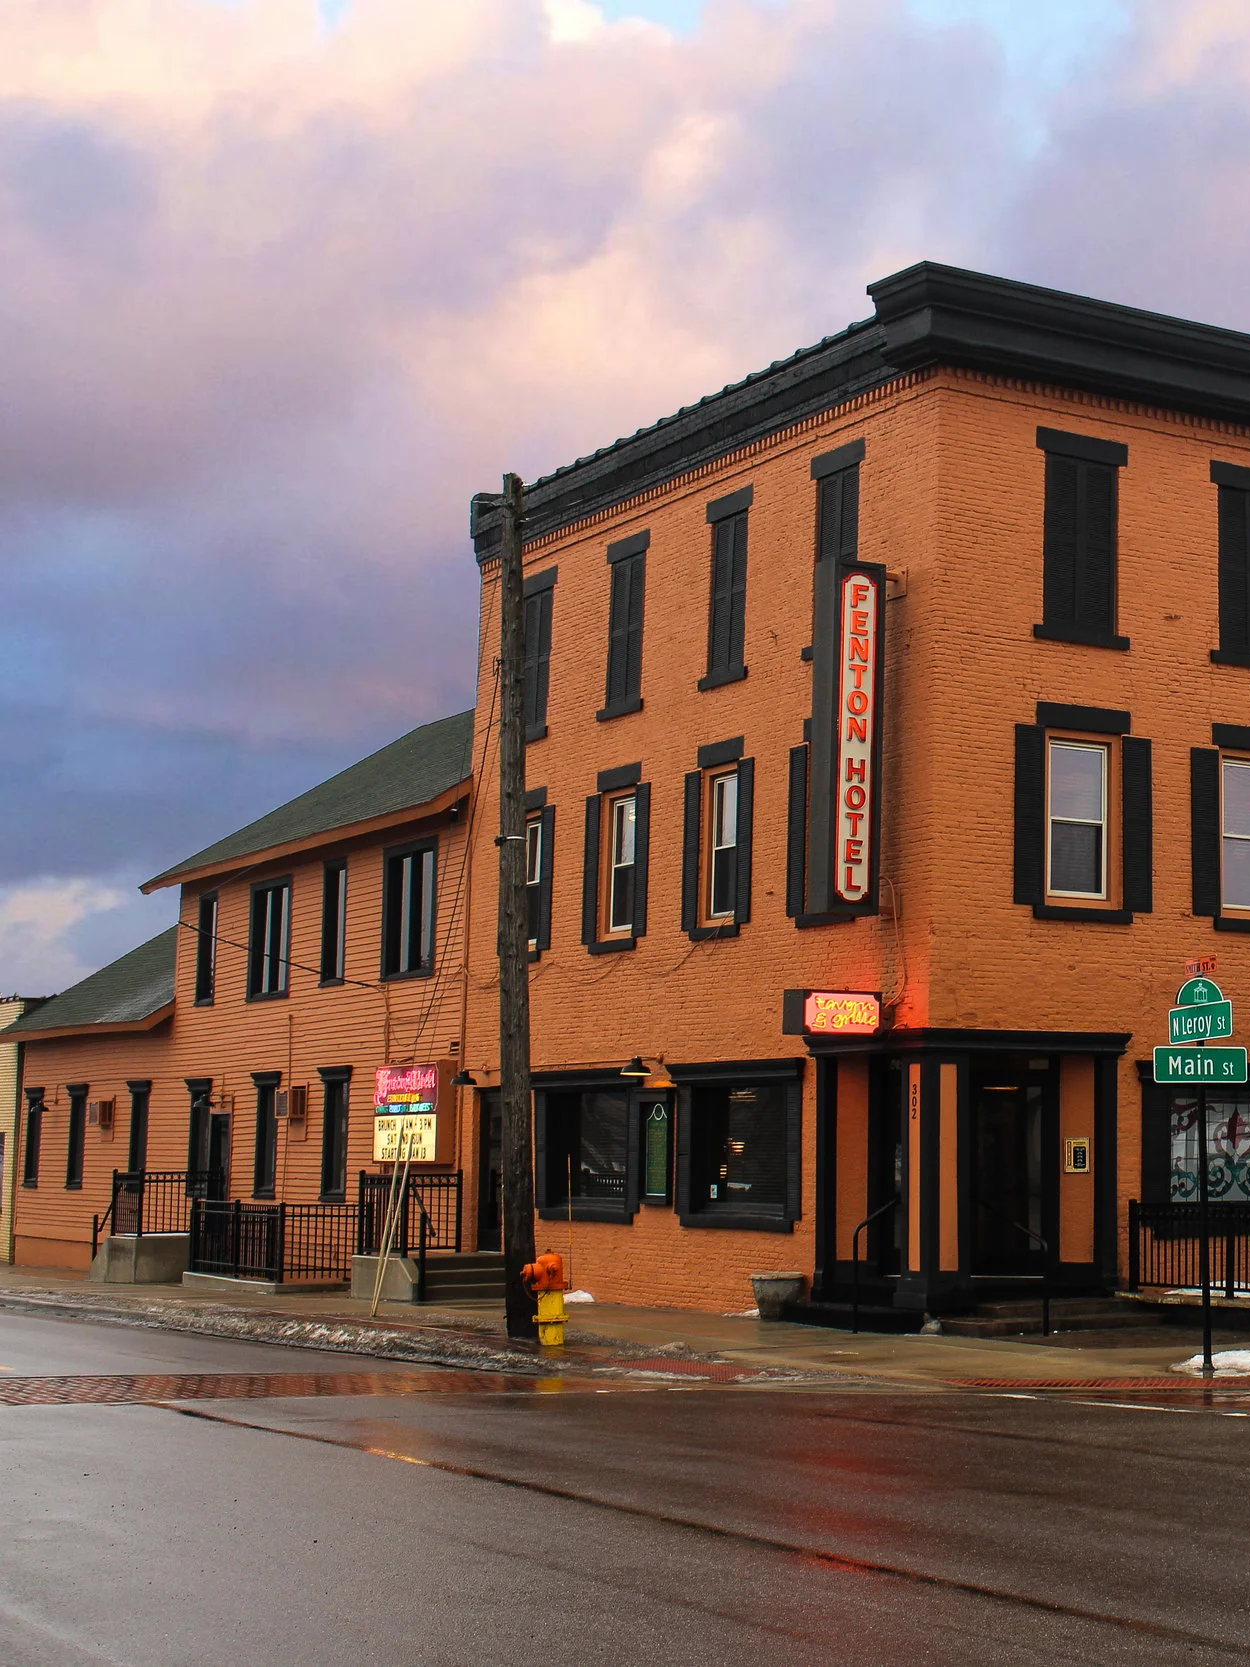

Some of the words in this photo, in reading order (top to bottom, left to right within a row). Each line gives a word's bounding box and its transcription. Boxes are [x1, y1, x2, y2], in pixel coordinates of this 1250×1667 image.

[847, 584, 869, 743] FENTON
[845, 757, 866, 891] HOTEL
[815, 996, 874, 1012] tavern
[832, 1010, 877, 1029] grille
[1173, 1017, 1179, 1037] N
[1182, 1015, 1212, 1037] Leroy
[1168, 1054, 1214, 1075] Main
[378, 1119, 397, 1131] BRUNCH
[387, 1133, 397, 1145] SAT
